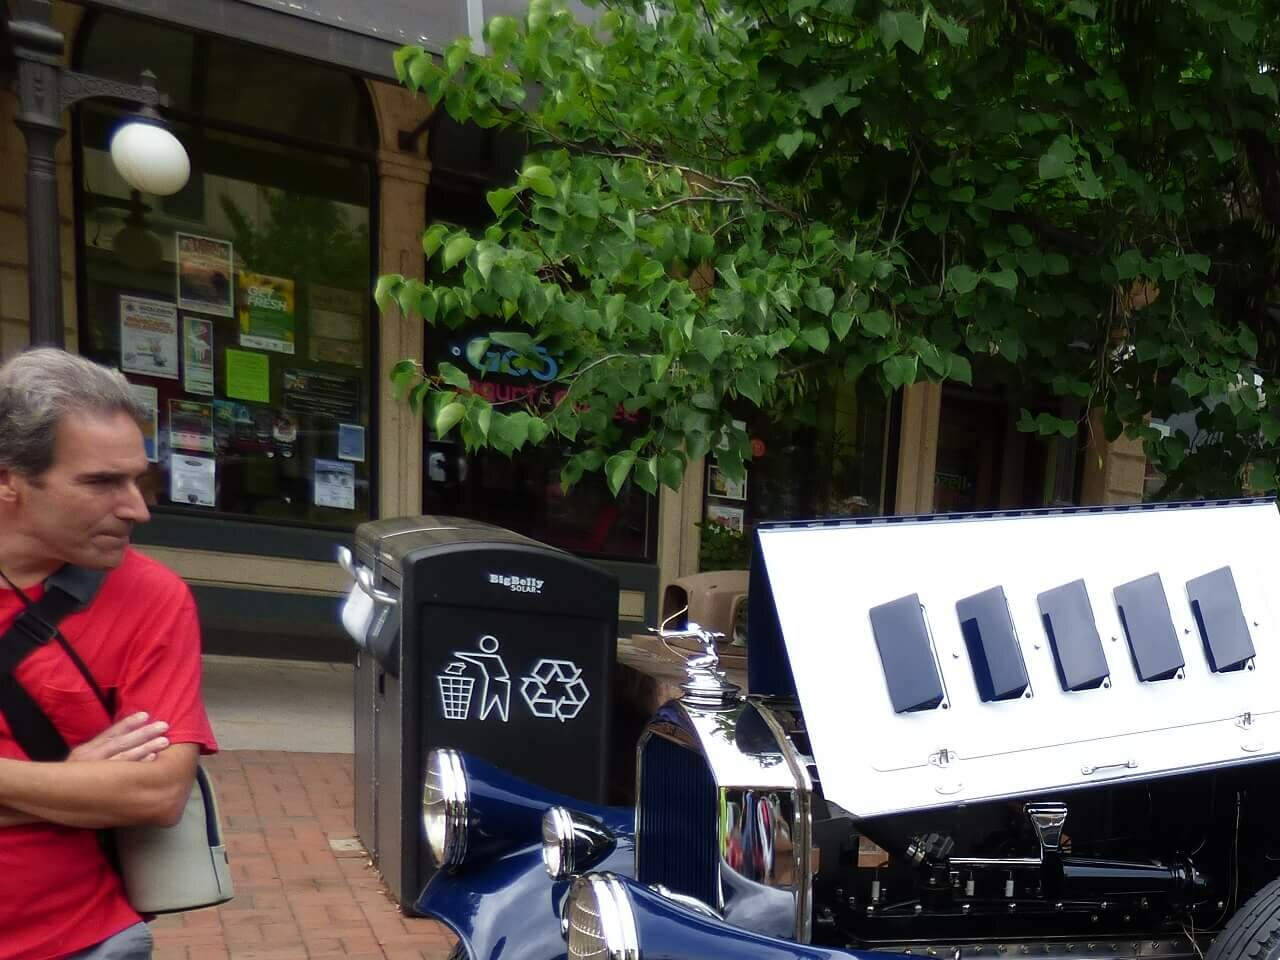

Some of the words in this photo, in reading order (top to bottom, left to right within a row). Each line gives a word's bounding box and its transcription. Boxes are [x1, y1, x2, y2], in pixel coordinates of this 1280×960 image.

[247, 295, 288, 312] FRESH
[489, 574, 544, 588] BigBelly
[511, 585, 537, 593] SOLAR
